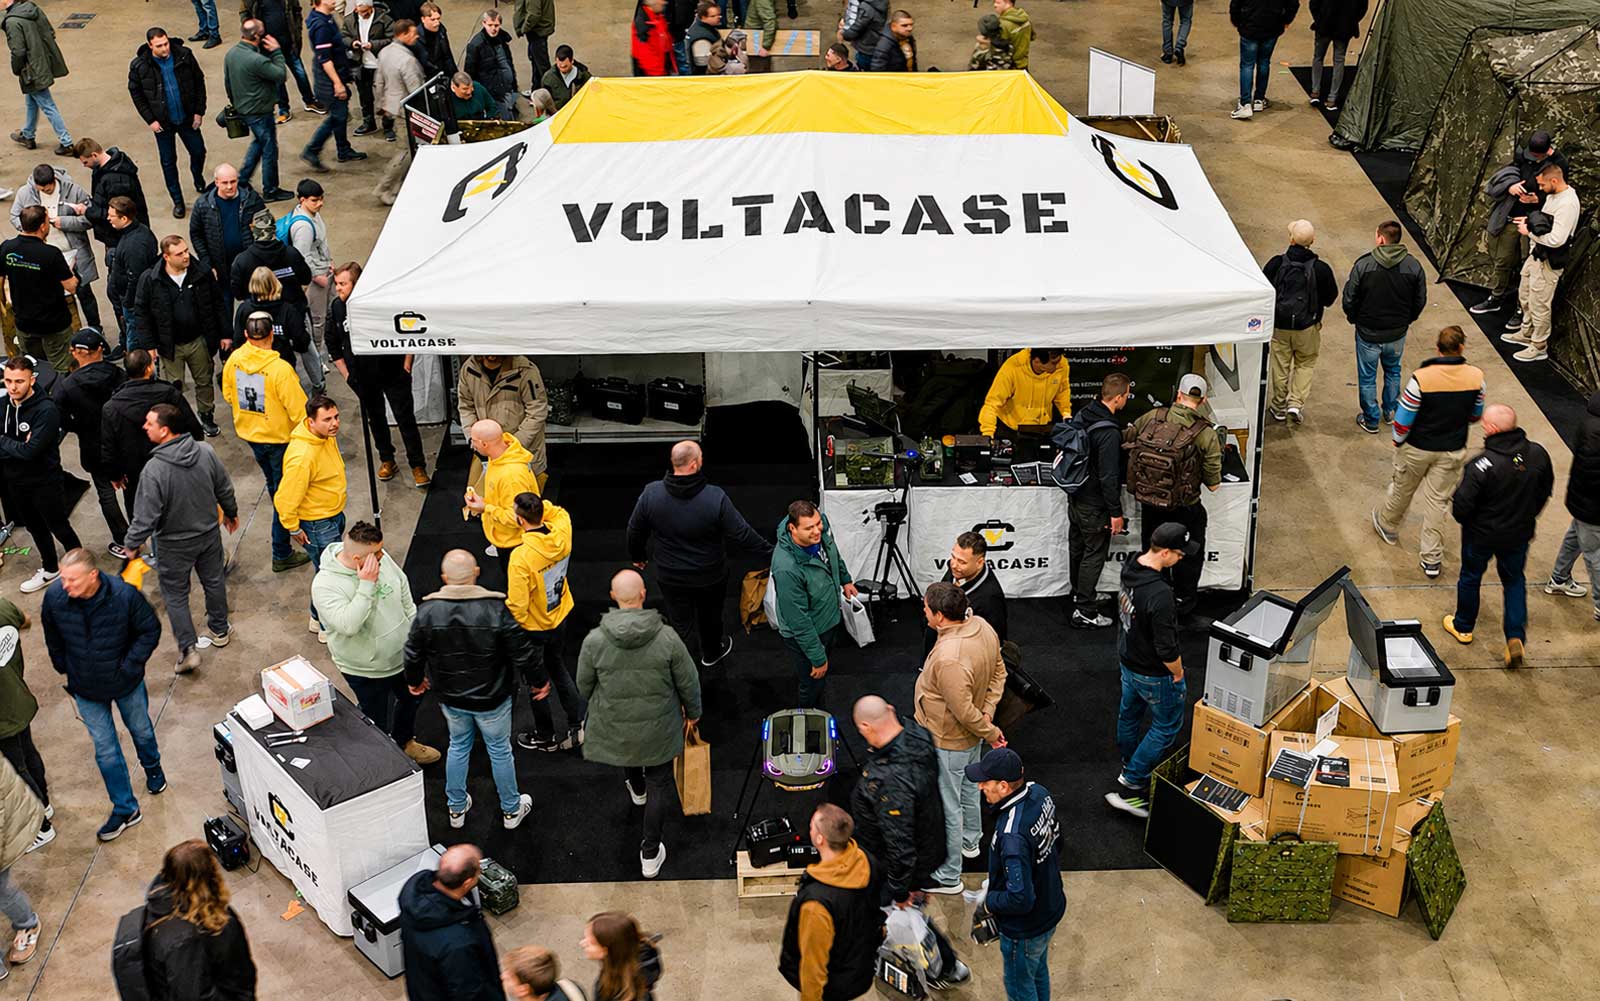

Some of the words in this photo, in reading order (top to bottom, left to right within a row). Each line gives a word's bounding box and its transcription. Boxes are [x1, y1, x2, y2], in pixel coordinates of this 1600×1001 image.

[563, 191, 1069, 243] VOLTACASE
[370, 338, 456, 348] VOLTACASE
[935, 557, 1049, 570] VACASE
